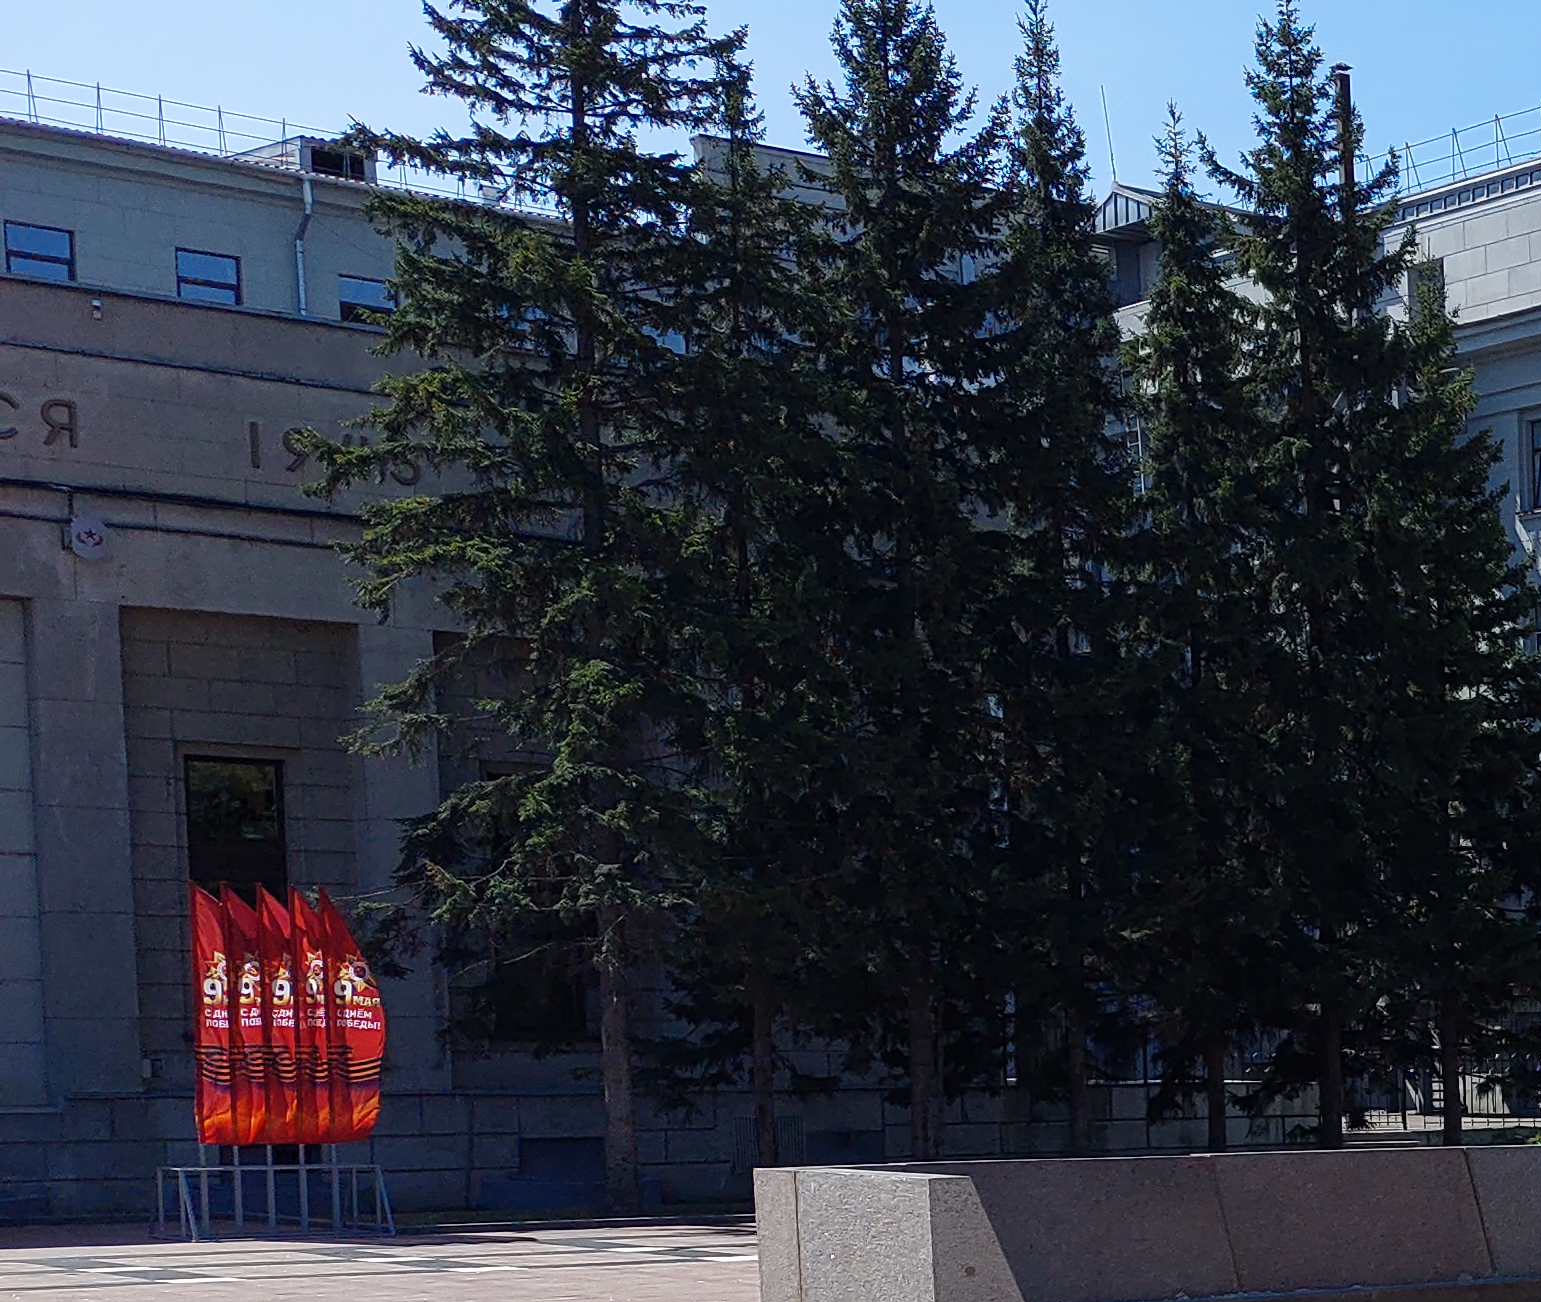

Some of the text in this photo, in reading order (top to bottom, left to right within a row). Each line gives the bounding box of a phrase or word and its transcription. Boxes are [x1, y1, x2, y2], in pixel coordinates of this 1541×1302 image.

[203, 978, 223, 1006] 9
[239, 978, 255, 1005] 9
[272, 979, 291, 1006] 9
[333, 979, 353, 1006] 9
